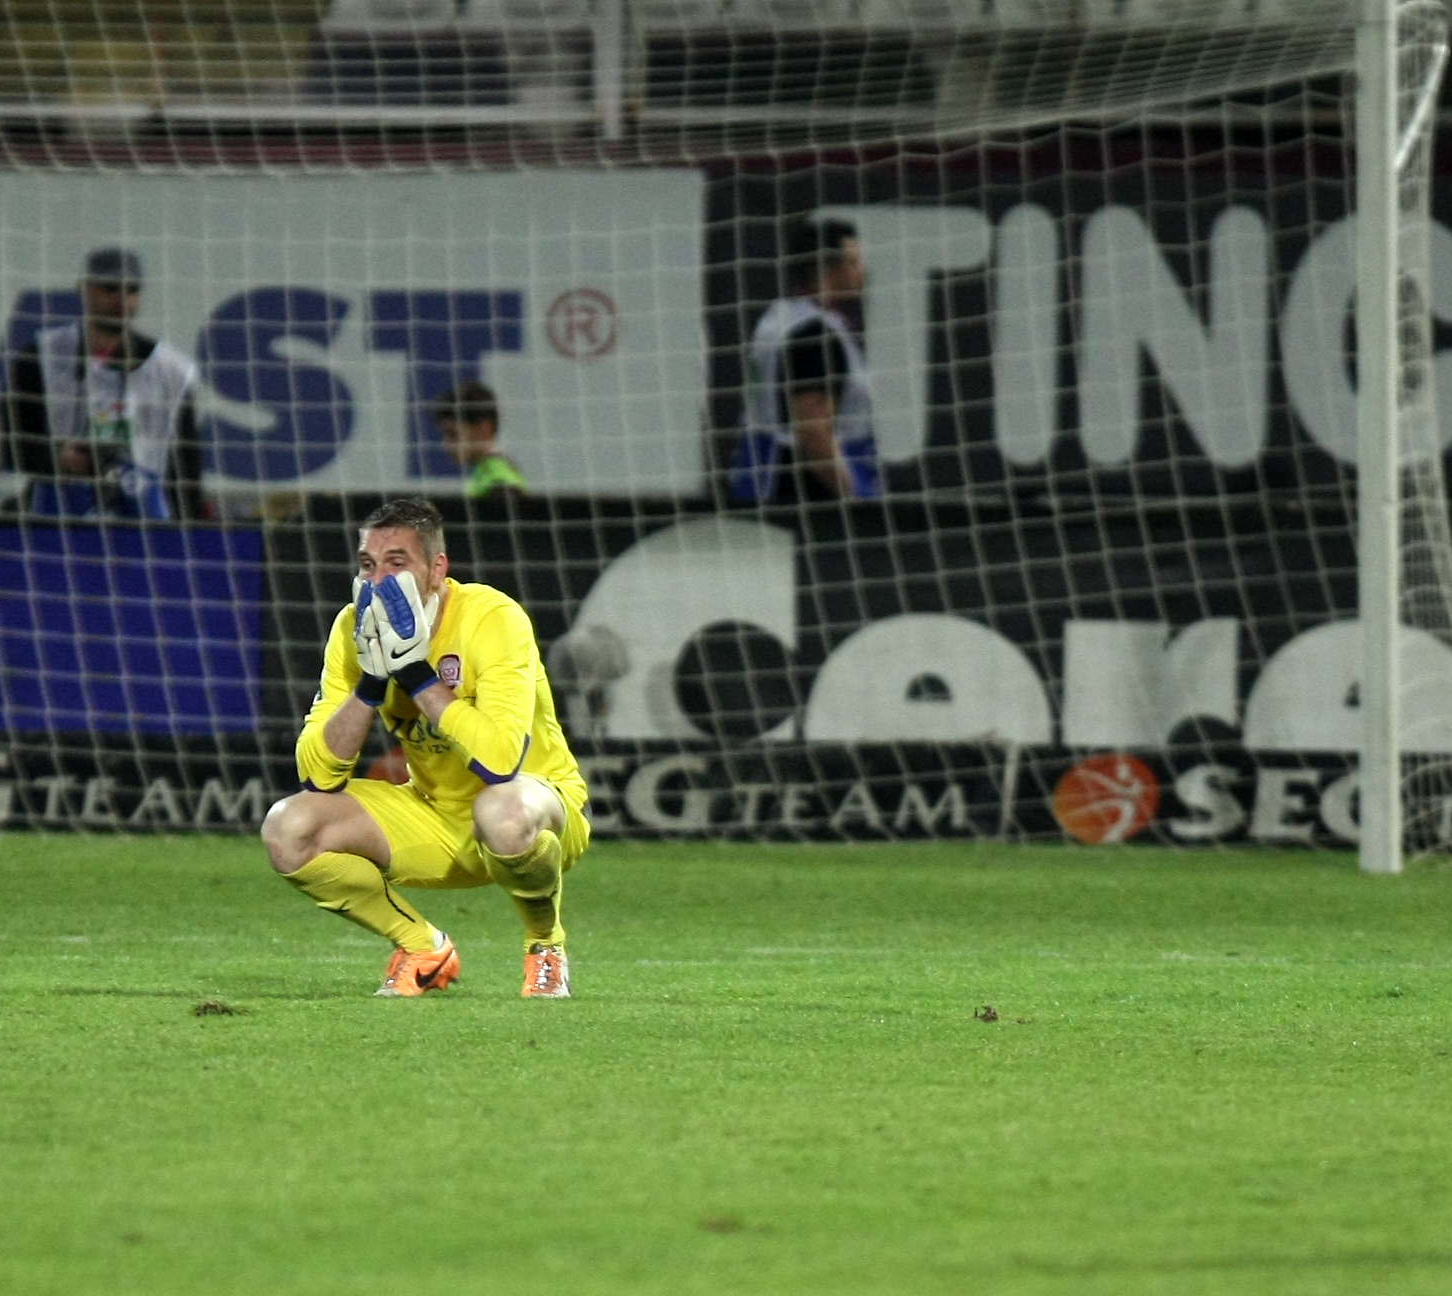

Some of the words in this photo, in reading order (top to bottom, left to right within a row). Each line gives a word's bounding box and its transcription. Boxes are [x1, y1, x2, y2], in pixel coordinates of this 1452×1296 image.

[36, 775, 262, 827] TEAM
[579, 755, 710, 831] EG
[735, 783, 969, 831] TEAM
